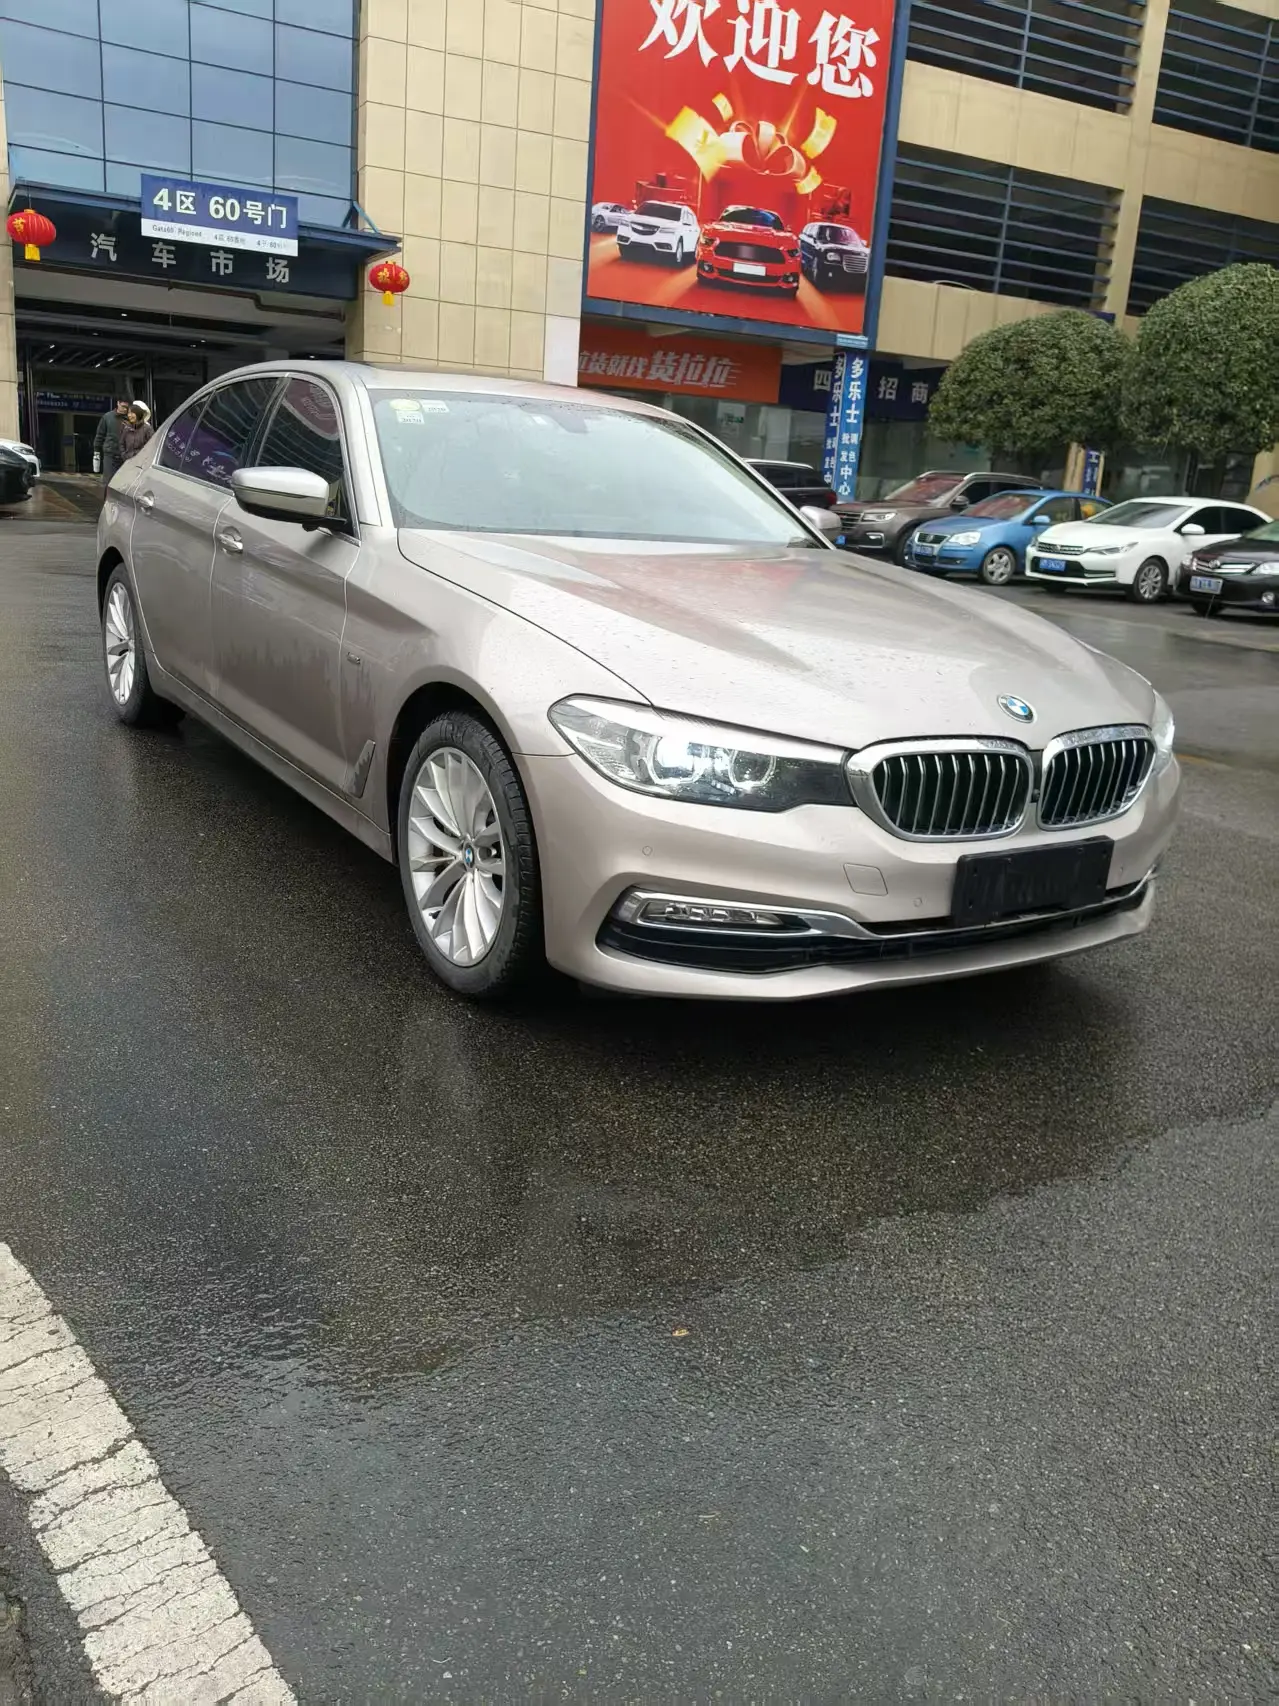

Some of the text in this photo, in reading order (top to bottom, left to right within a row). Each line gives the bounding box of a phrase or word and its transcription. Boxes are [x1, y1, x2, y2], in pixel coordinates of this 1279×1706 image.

[638, 0, 880, 98] 欢迎您
[152, 187, 287, 229] 4区 60号门
[90, 232, 290, 283] 汽车市场
[845, 357, 864, 424] 多乐士
[878, 375, 929, 405] 招商
